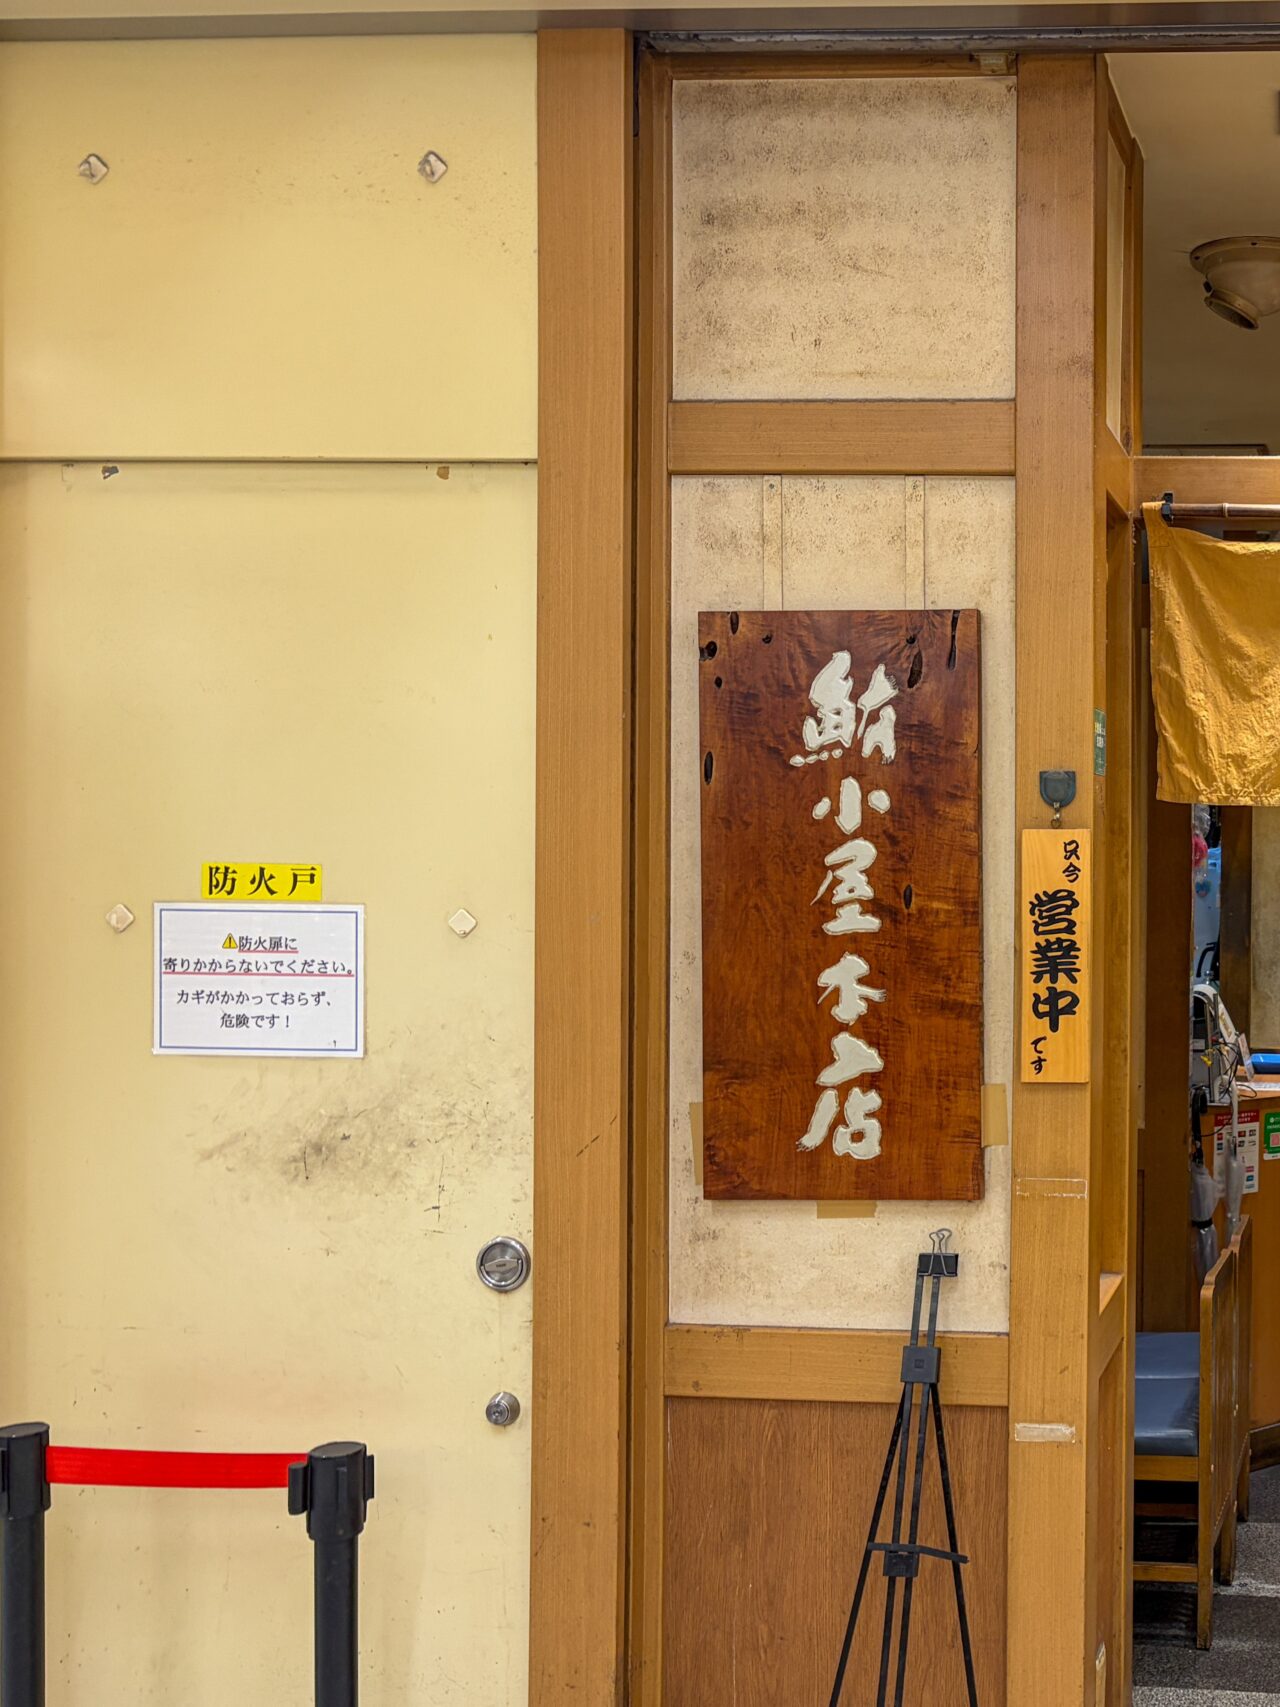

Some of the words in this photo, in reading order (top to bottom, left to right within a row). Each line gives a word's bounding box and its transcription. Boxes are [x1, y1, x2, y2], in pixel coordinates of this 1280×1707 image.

[208, 866, 317, 896] 防火戸
[238, 935, 298, 951] 防火扉に
[163, 957, 355, 975] 寄りかからないでください。
[1029, 889, 1082, 1033] 営業中
[177, 989, 332, 1006] カギがかかっておらず、
